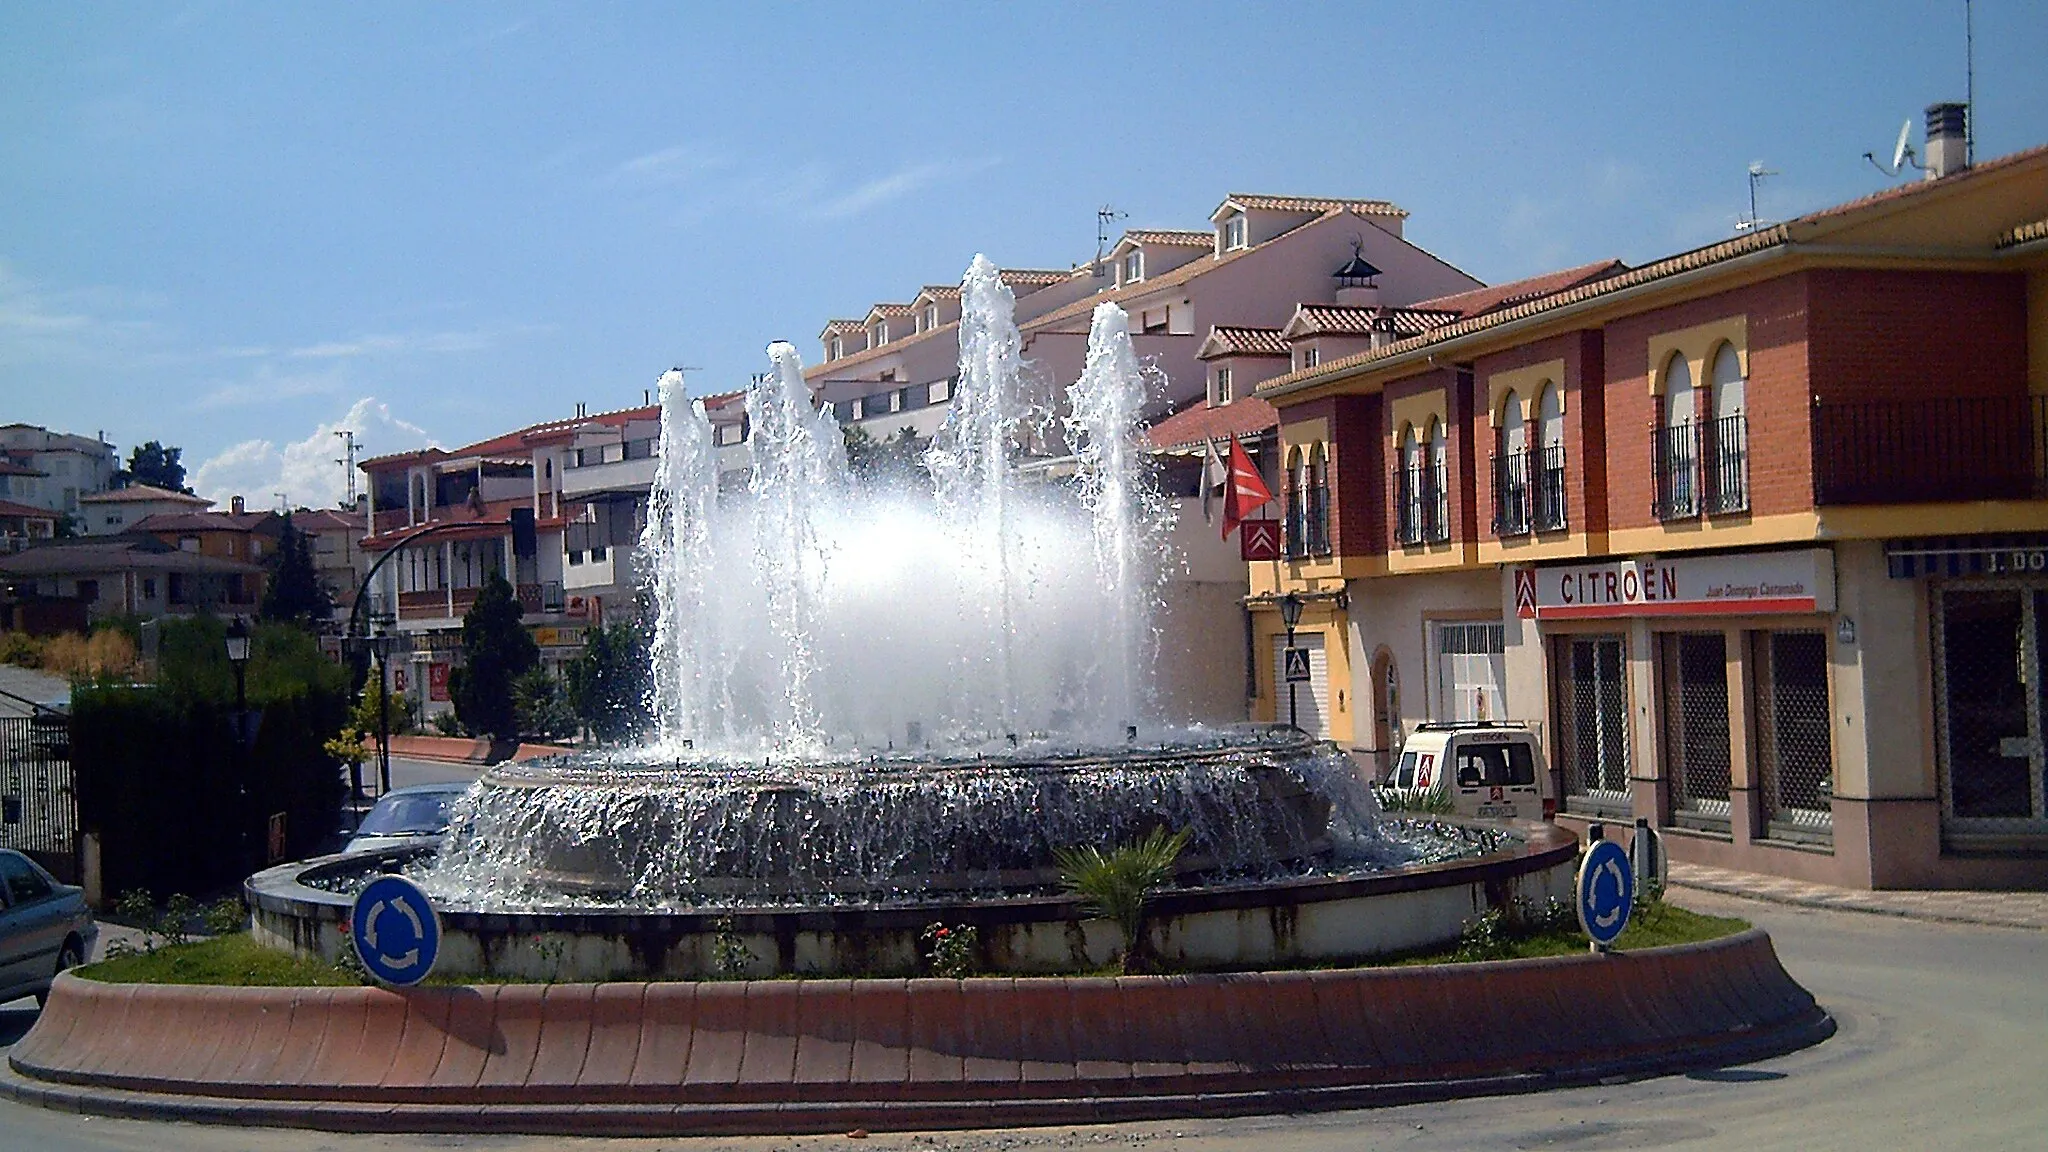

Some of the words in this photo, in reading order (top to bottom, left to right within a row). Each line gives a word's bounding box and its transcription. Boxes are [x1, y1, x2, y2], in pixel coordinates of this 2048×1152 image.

[1561, 562, 1677, 604] CITROËN
[1706, 585, 1723, 597] Juan
[1725, 583, 1758, 598] Domingo
